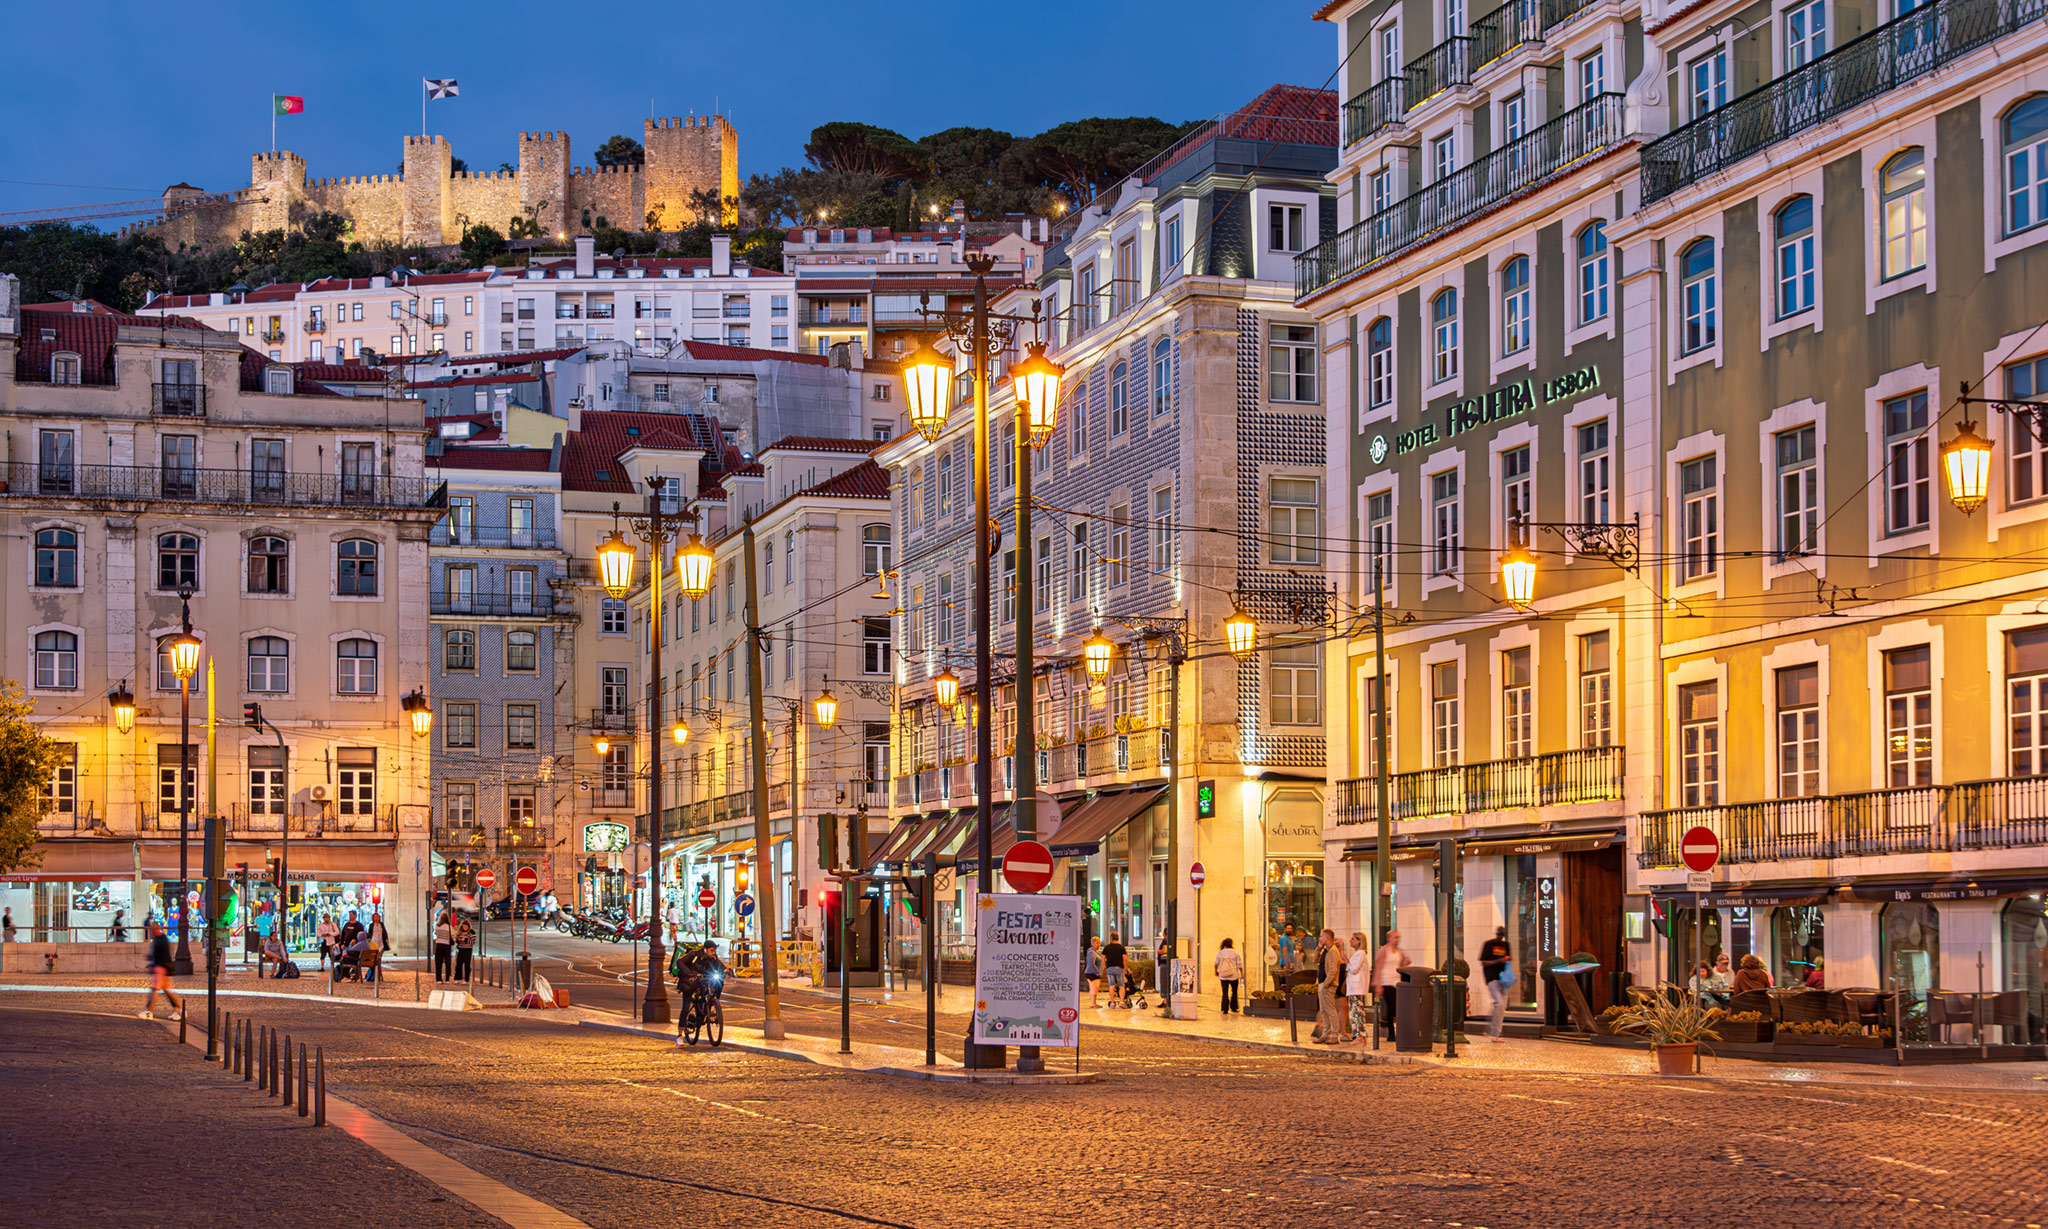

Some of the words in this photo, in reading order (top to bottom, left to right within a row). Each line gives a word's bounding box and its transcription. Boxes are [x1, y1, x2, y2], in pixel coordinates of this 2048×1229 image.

[1397, 425, 1440, 454] HOTEL
[1446, 379, 1535, 437] FIGUEIRA
[1543, 365, 1600, 404] LISBOA
[581, 781, 589, 791] S
[1272, 828, 1319, 836] SQUADRA
[1921, 891, 1957, 899] RESTAURANTE
[997, 911, 1042, 929] FESTA
[1007, 953, 1060, 961] CONCERTOS
[1025, 961, 1056, 969] CINEMA
[995, 969, 1024, 977] ESPAÇOS
[1031, 983, 1073, 991] DEBATES
